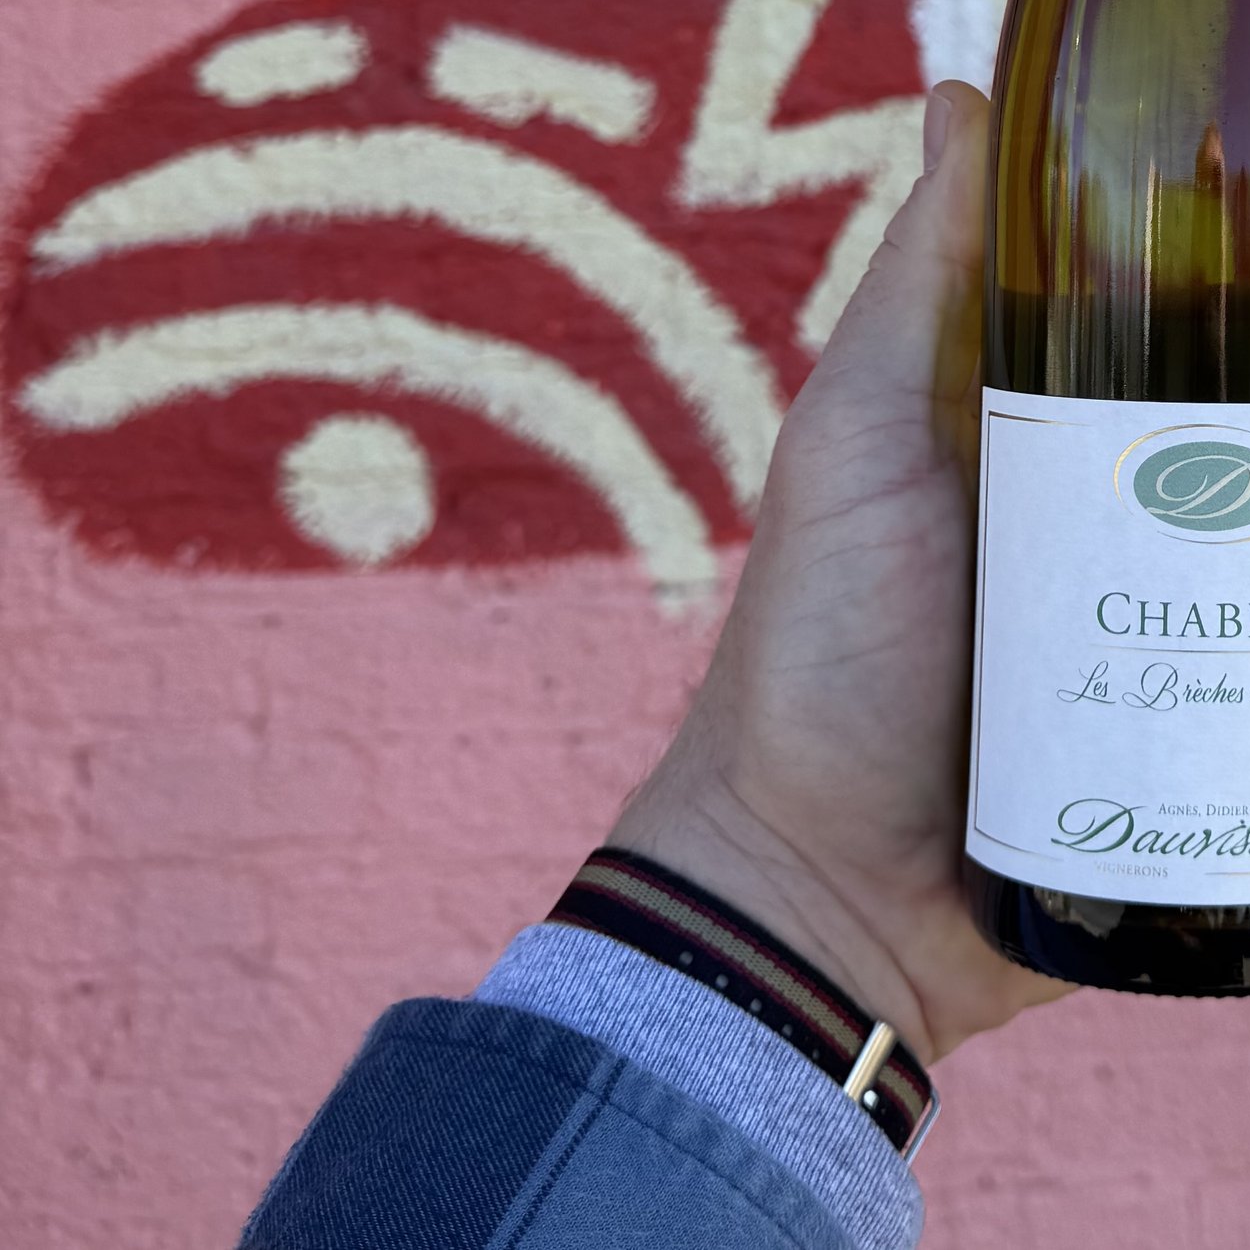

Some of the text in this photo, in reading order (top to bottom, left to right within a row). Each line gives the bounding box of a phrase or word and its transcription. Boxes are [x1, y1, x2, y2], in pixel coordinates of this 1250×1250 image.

[1056, 660, 1117, 704] Les
[1121, 661, 1245, 712] Brèches
[1205, 802, 1250, 817] DIDIER
[1094, 860, 1169, 879] VIGNERONS
